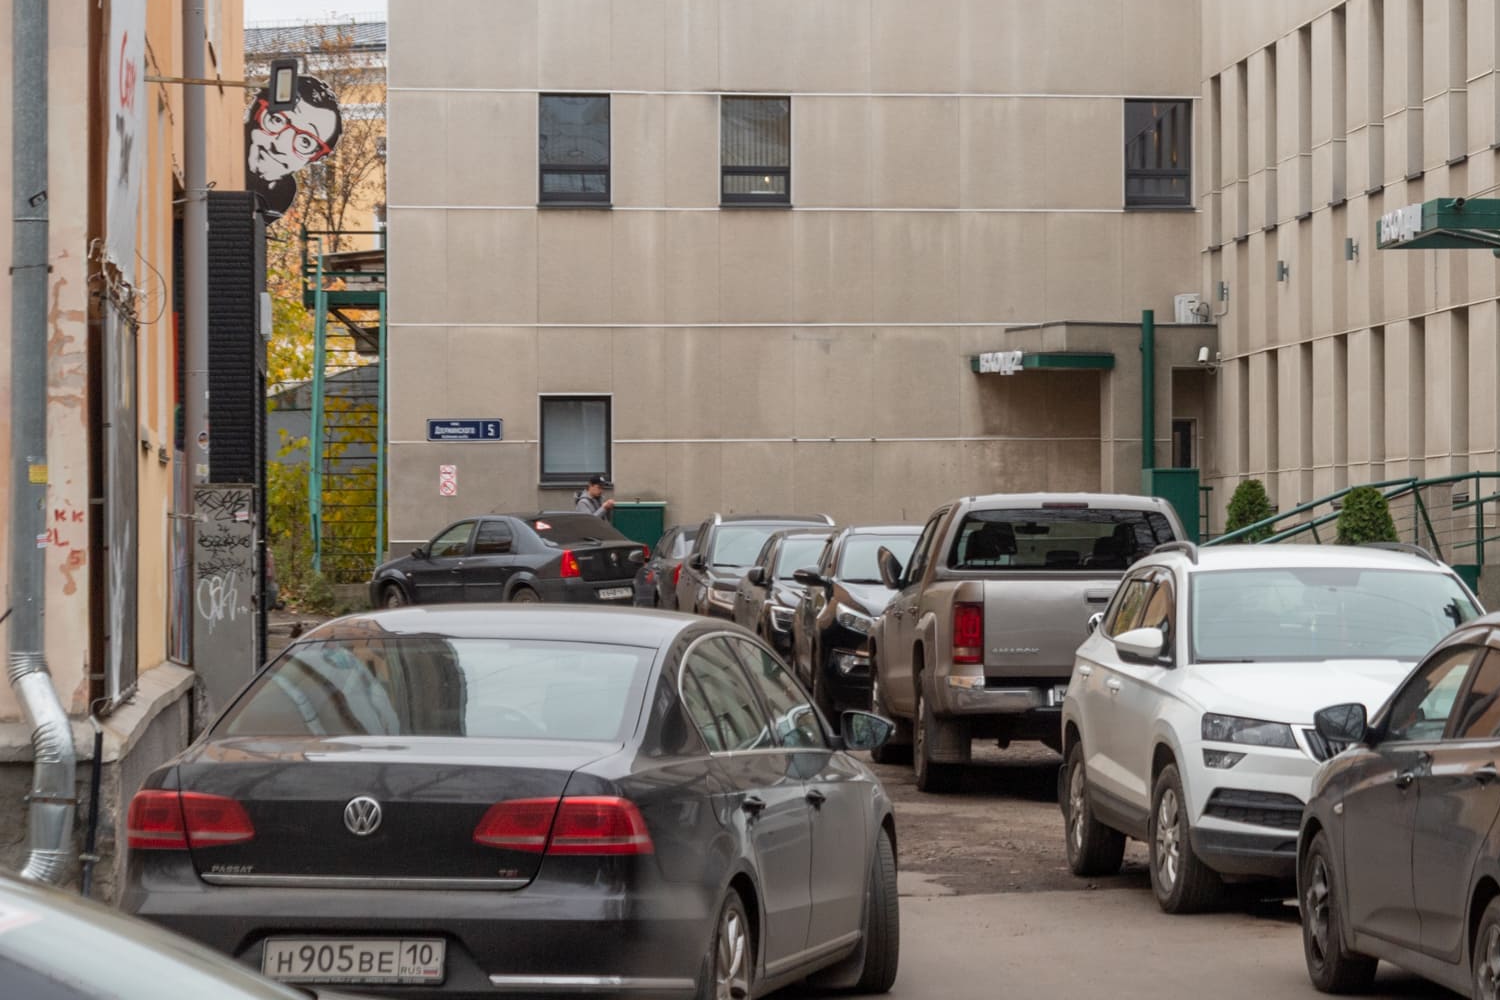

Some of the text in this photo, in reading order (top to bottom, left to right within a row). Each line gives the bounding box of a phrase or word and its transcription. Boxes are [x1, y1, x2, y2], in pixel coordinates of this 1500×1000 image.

[487, 423, 496, 436] 5
[211, 865, 253, 873] PASSAT
[406, 943, 433, 966] 10
[400, 967, 422, 975] RUS
